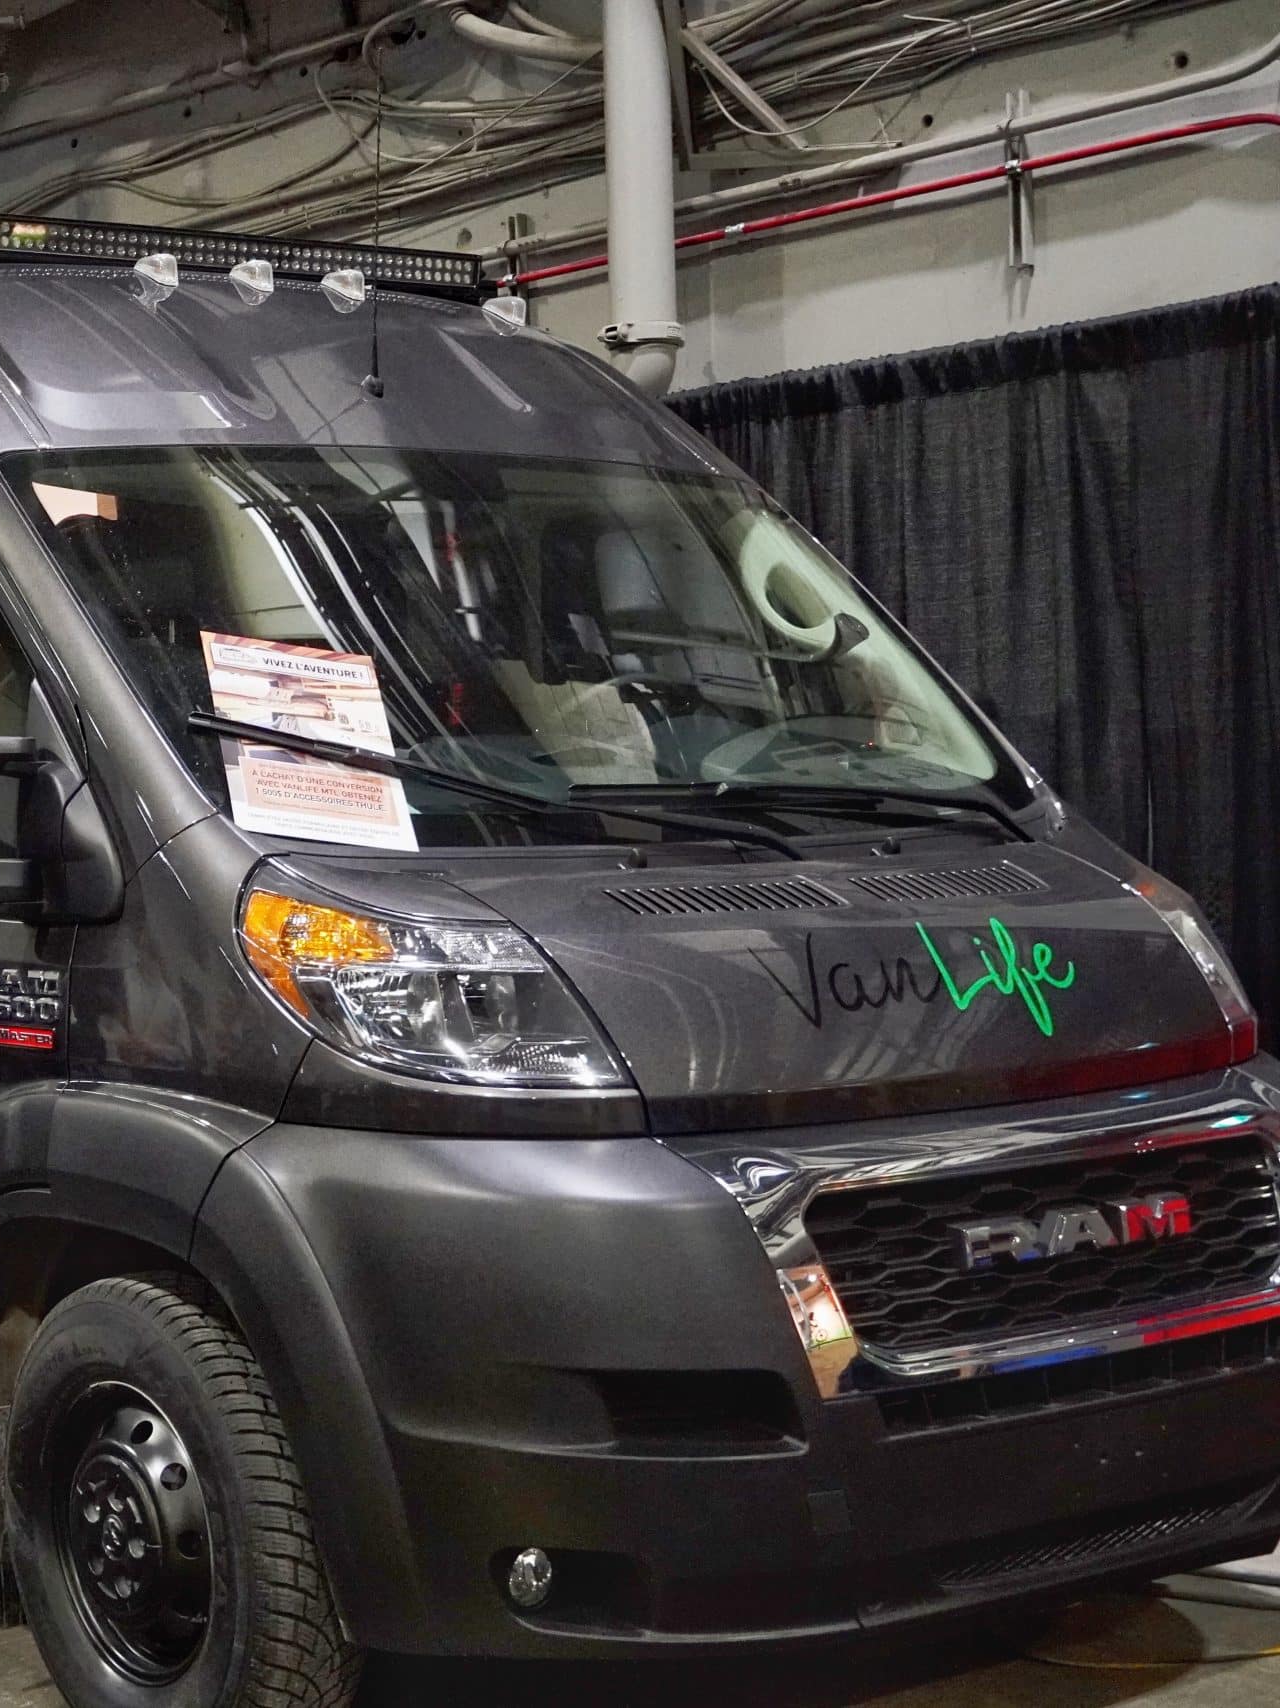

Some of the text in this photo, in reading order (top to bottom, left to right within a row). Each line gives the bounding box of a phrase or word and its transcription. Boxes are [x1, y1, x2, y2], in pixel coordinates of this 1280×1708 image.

[262, 656, 294, 671] VIVEZ
[295, 662, 358, 680] L'AVENTURE
[257, 778, 383, 803] AVEC VANLIFE MTL OBTENEZ
[297, 774, 325, 786] D'UNE
[327, 779, 383, 794] CONVERSION
[284, 791, 354, 808] D'ACCESSOIRES
[947, 1191, 1192, 1270] RAM
